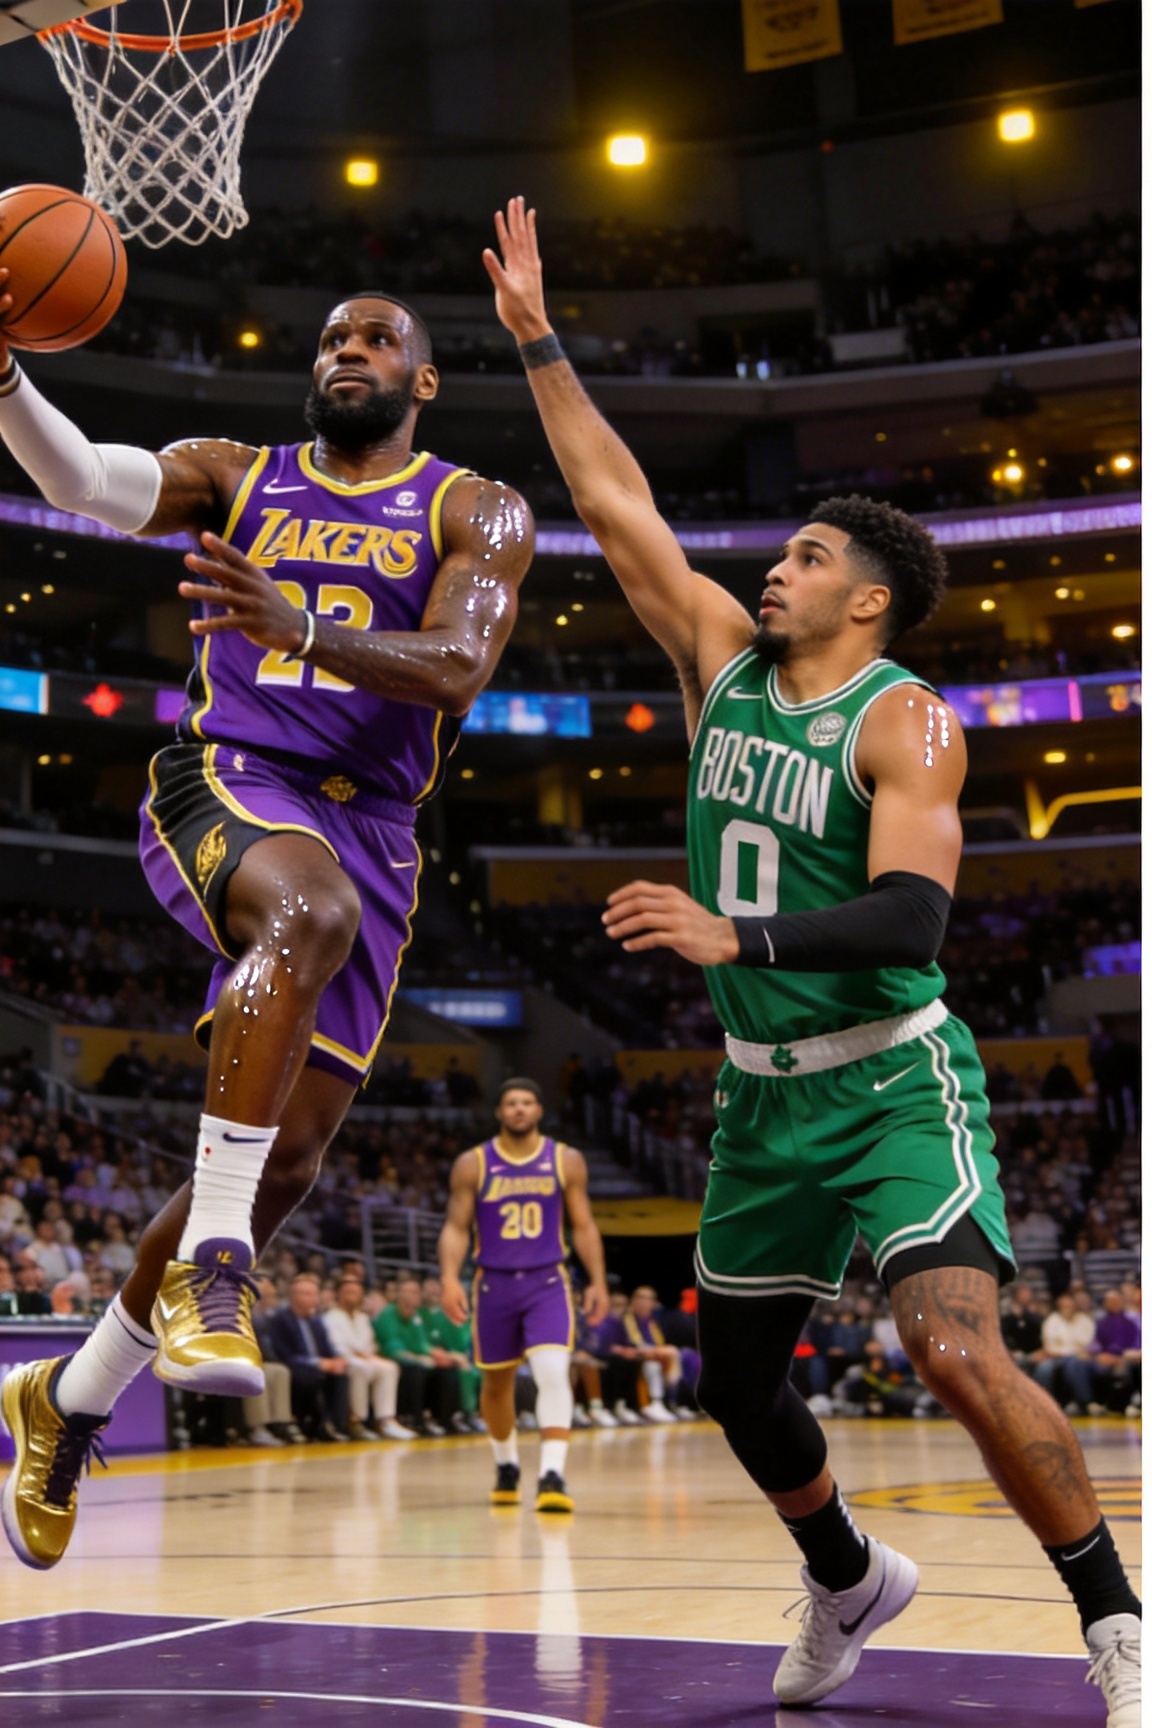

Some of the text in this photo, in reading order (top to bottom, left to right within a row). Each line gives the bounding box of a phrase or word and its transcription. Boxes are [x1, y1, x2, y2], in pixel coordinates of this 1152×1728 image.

[246, 507, 423, 579] LAKERS
[696, 727, 835, 840] BOSTON
[717, 818, 780, 917] 0
[498, 1200, 544, 1240] 20
